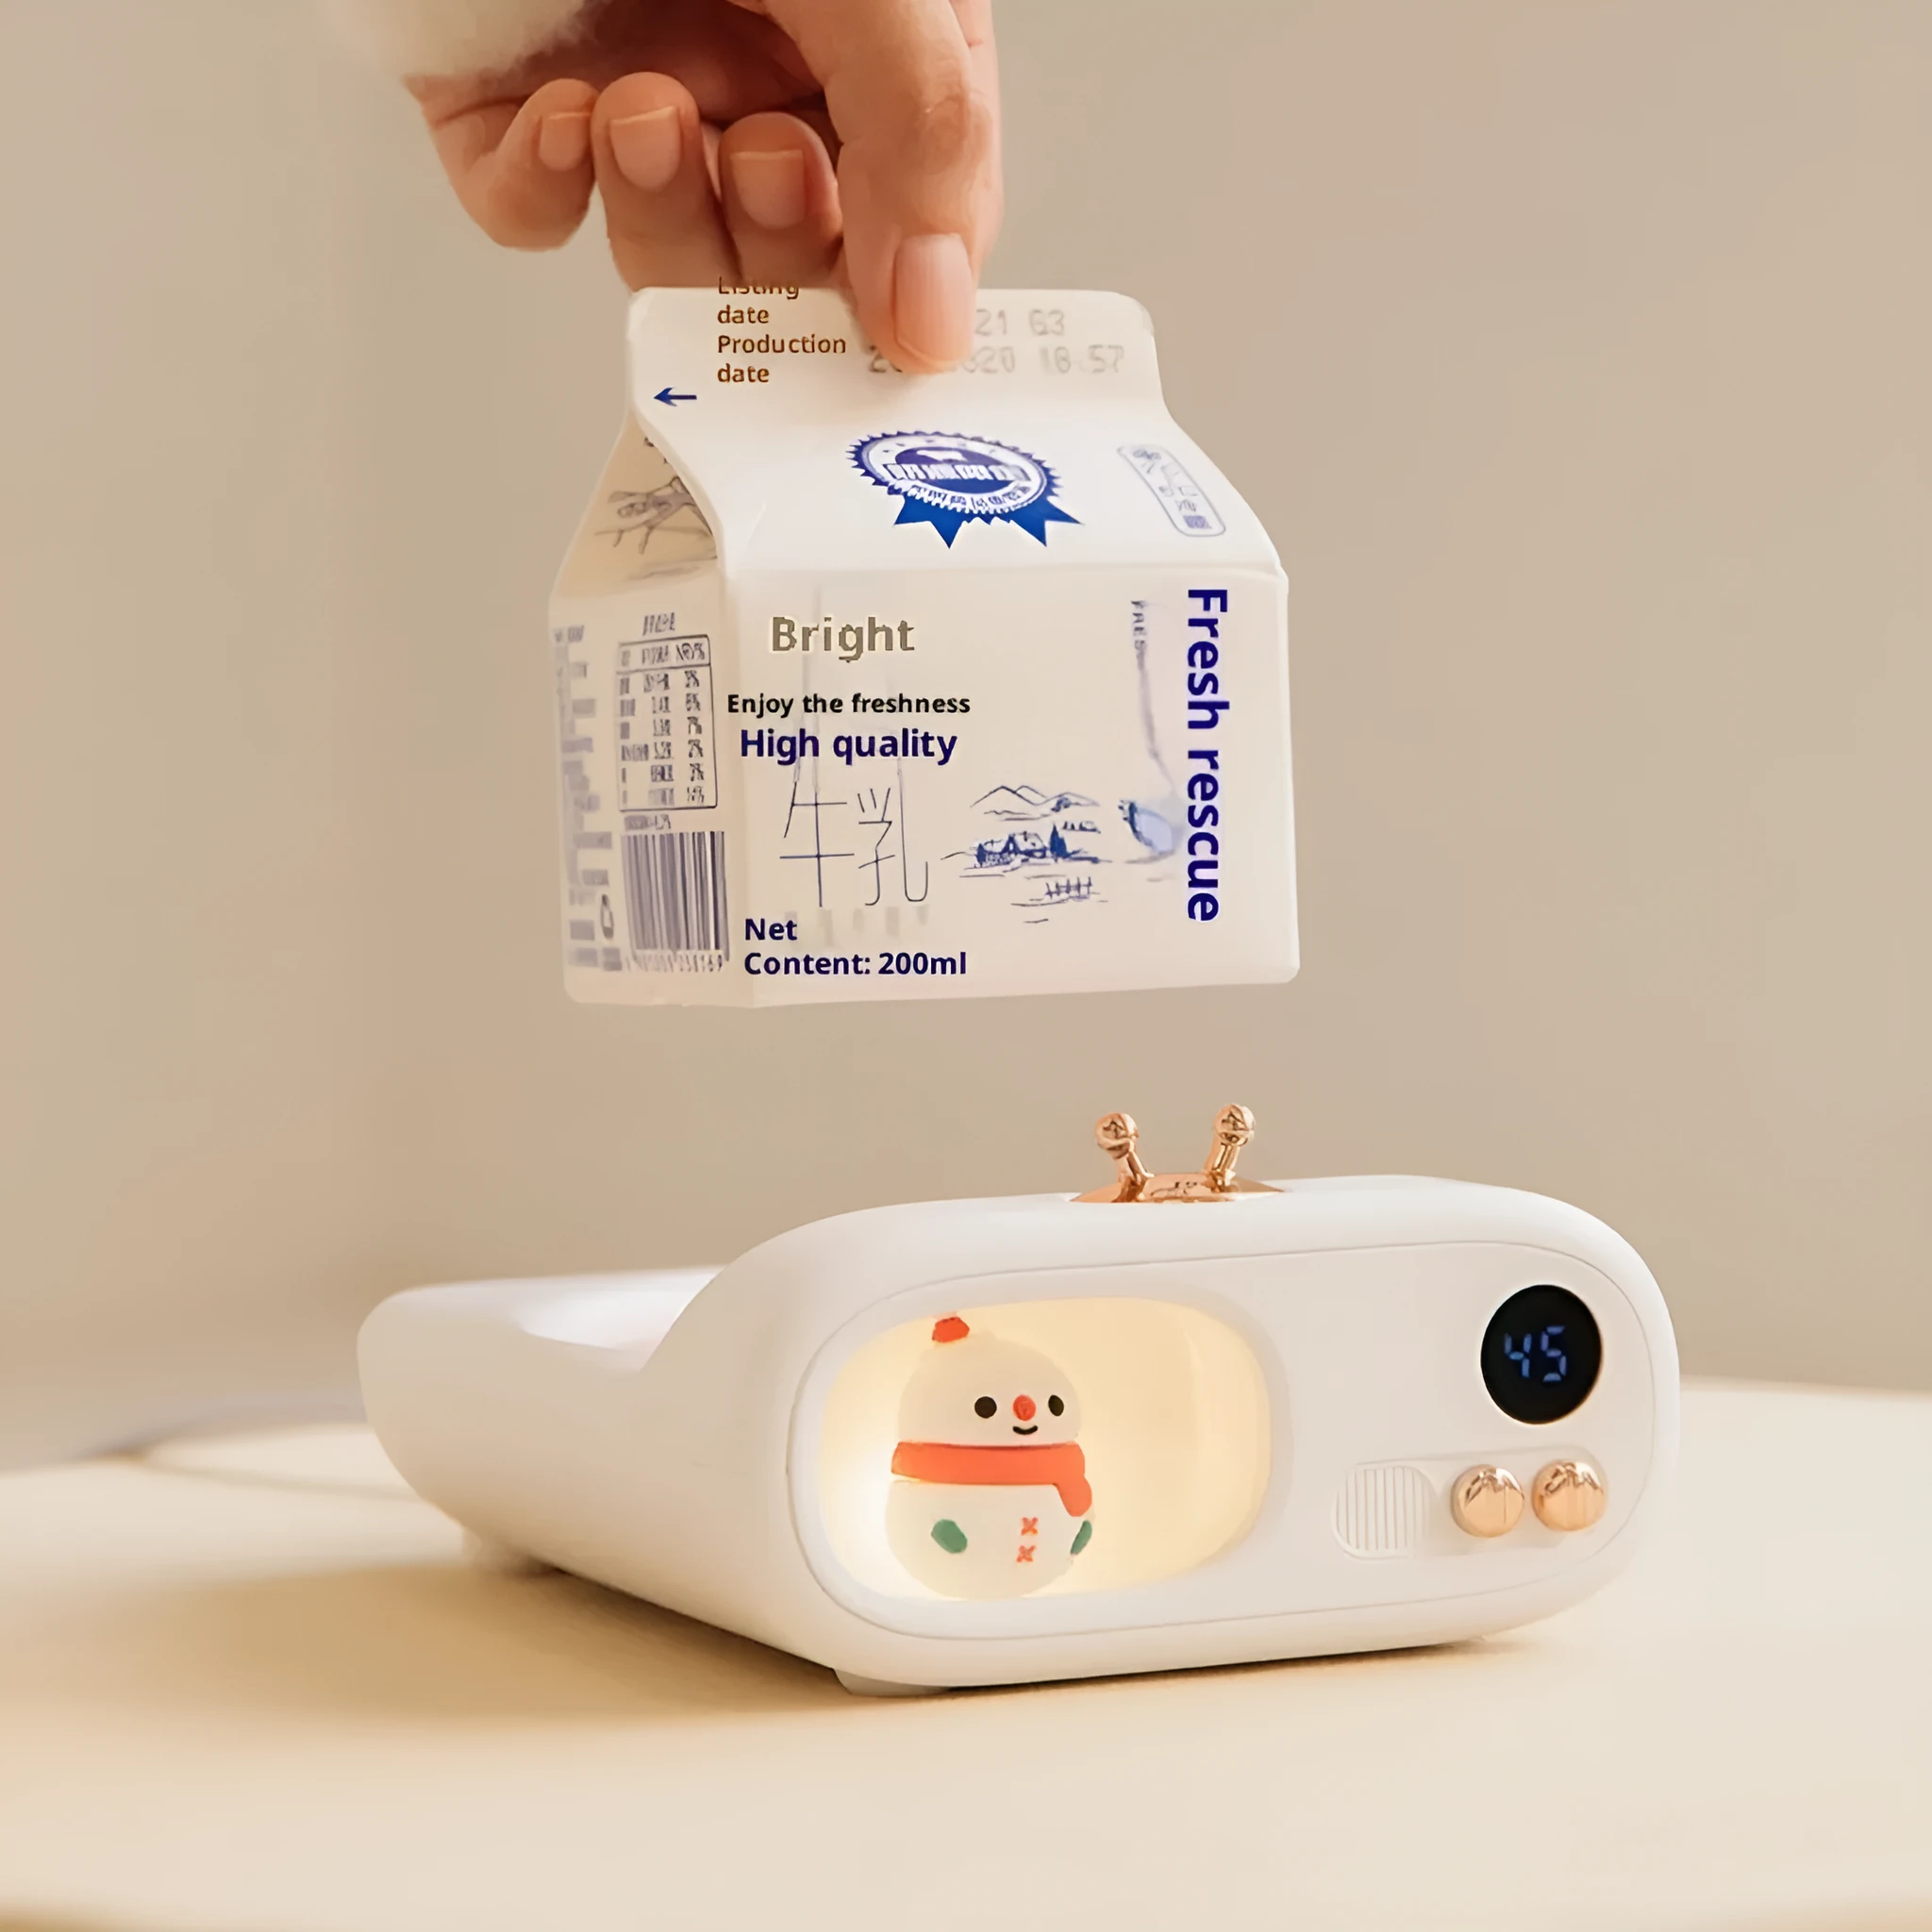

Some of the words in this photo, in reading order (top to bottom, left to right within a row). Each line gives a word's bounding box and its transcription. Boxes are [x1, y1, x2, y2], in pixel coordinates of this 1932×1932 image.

[717, 305, 770, 325] date
[718, 334, 846, 354] Production
[717, 363, 770, 383] date
[771, 616, 916, 662] Bright
[1187, 589, 1230, 730] Fresh
[727, 692, 794, 717] Enjoy
[802, 692, 844, 714] the
[852, 692, 971, 714] freshness
[741, 727, 820, 766] High
[833, 727, 958, 766] quality
[1187, 750, 1220, 922] rescue
[744, 917, 798, 941] Net
[743, 951, 871, 975] Content:
[877, 951, 967, 975] 200ml
[1504, 1325, 1567, 1382] 45
